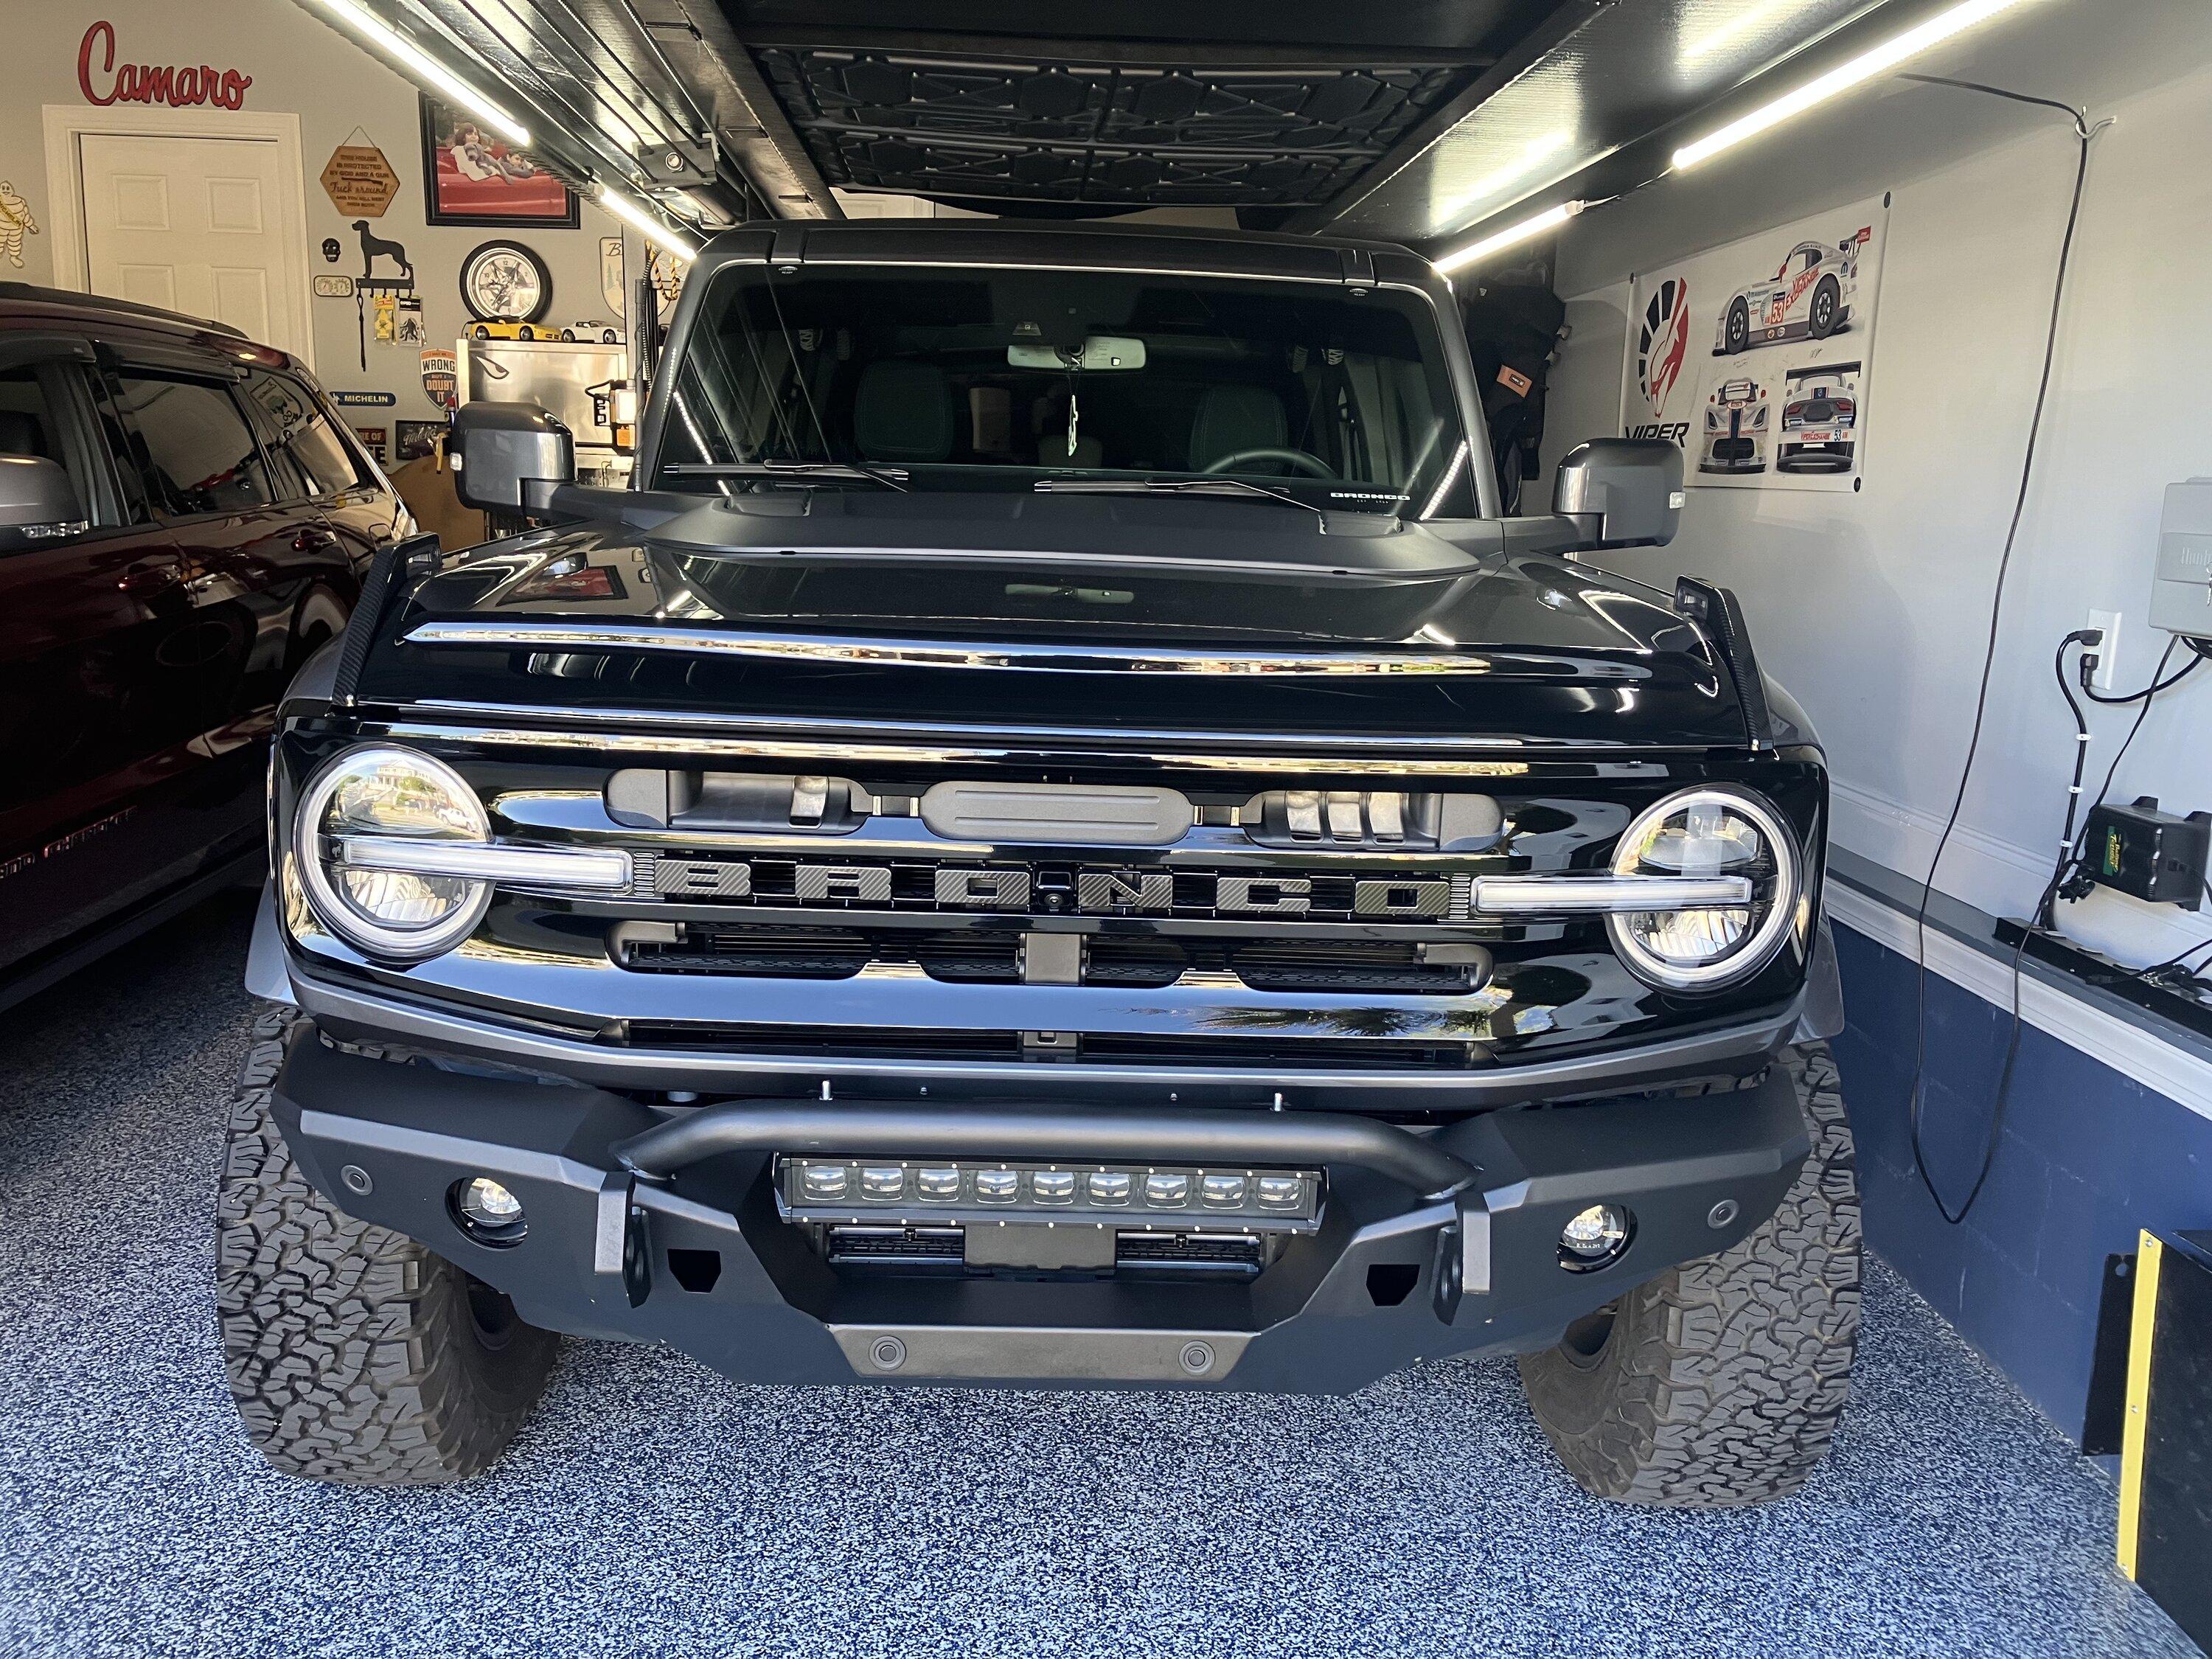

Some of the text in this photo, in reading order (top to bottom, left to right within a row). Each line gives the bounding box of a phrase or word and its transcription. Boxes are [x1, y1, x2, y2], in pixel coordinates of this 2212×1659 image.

[78, 21, 252, 110] Camaro
[1772, 302, 1784, 323] 53
[422, 358, 455, 372] WRONG
[426, 380, 453, 391] DOUBT
[437, 391, 445, 403] IT
[1625, 422, 1689, 448] VIPER
[655, 859, 1450, 915] BRONCO
